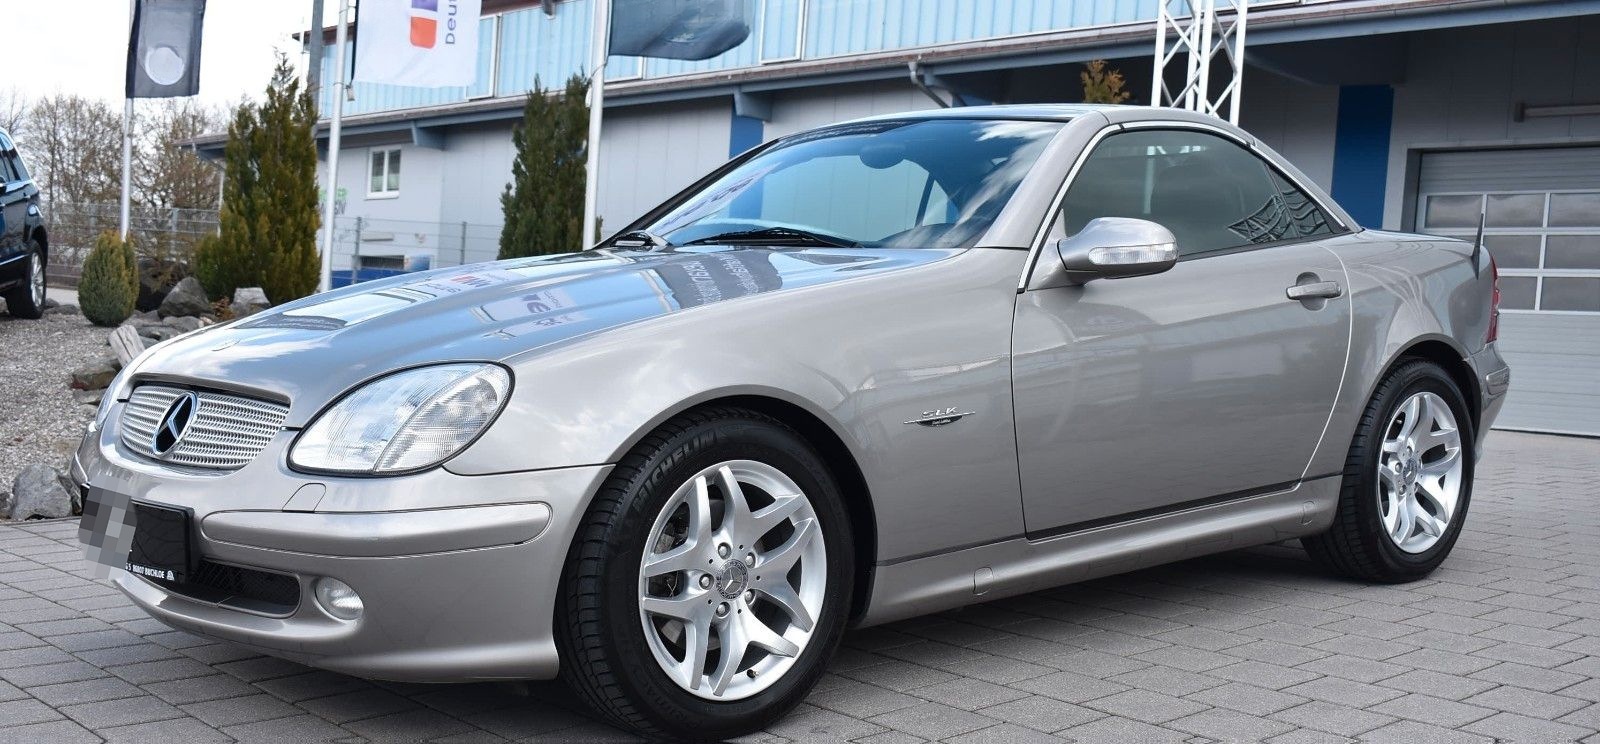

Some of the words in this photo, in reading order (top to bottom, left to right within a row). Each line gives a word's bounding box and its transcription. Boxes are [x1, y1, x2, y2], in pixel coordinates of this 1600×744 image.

[445, 0, 457, 44] Deu
[922, 406, 957, 418] SLK
[632, 431, 718, 513] MICHELIN
